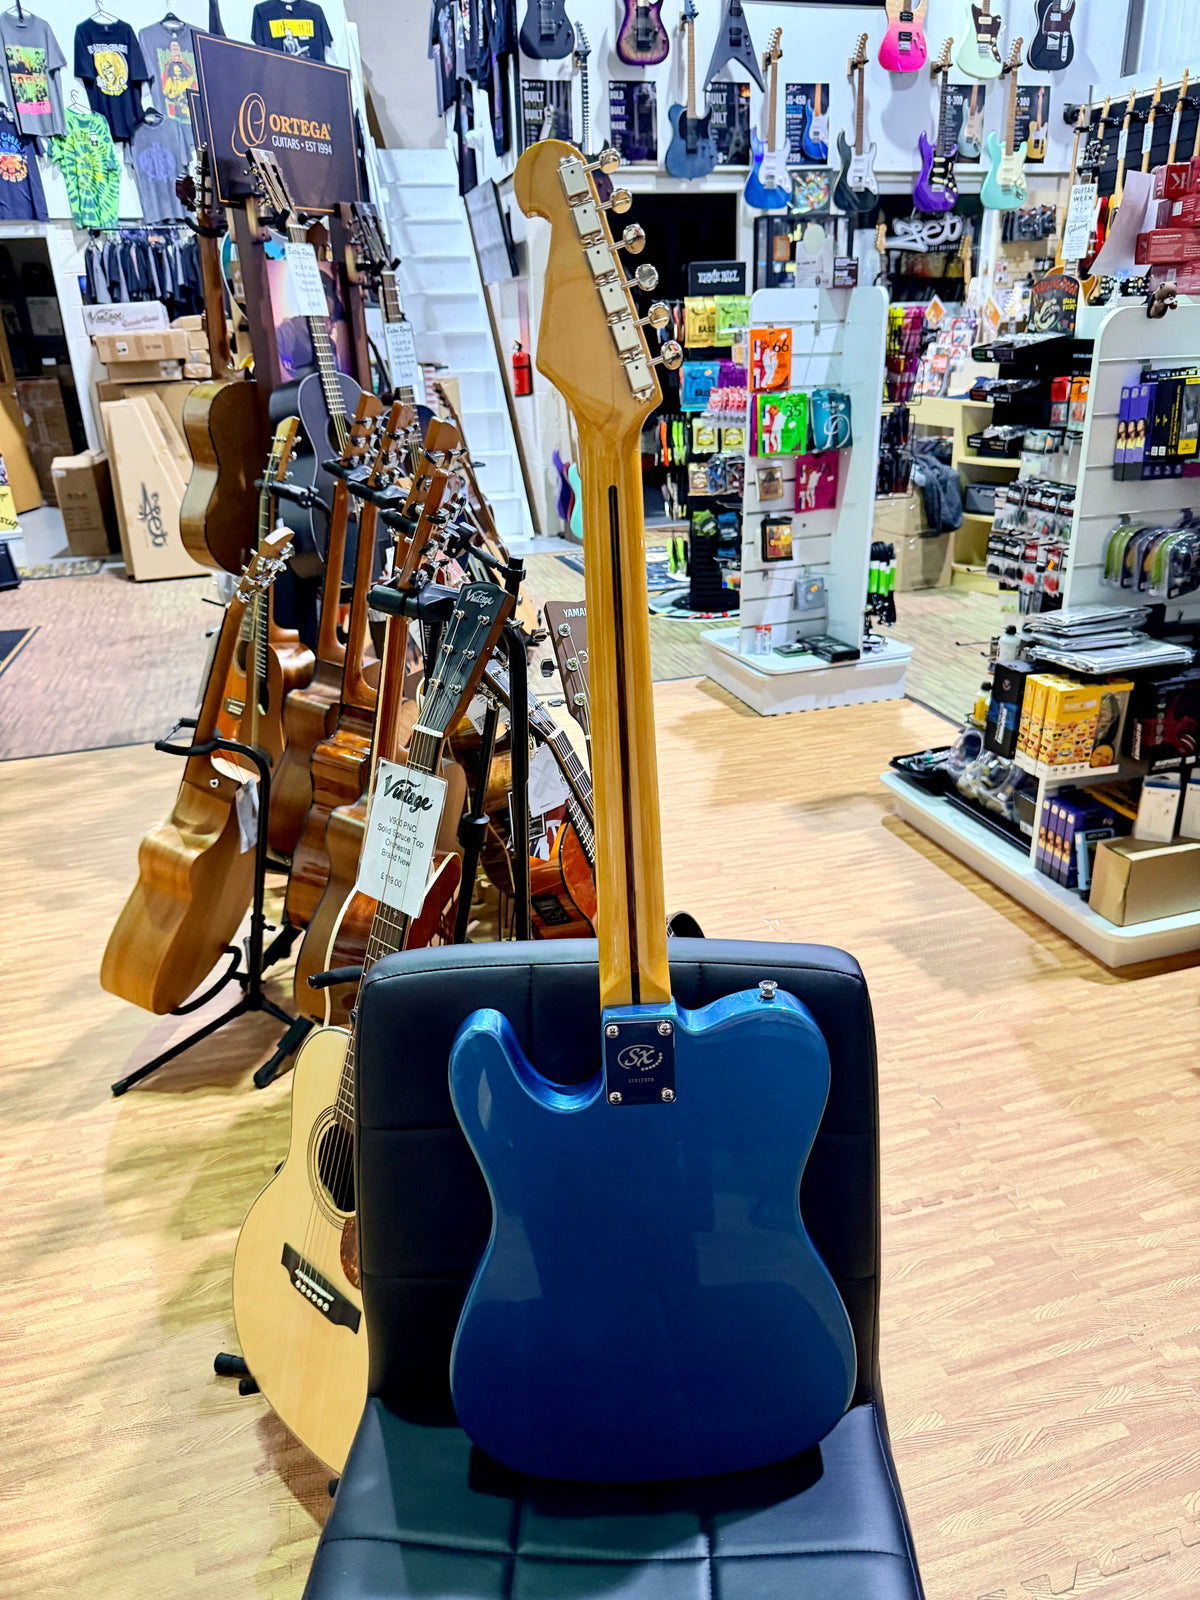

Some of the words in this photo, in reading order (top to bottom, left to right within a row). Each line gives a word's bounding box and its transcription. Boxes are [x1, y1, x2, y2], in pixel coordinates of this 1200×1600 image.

[523, 90, 544, 102] BUILT
[609, 90, 624, 100] BOLD
[524, 109, 543, 120] BUILT
[711, 111, 728, 124] UILT
[269, 113, 331, 140] ORTEGA
[271, 135, 301, 151] GUITARS
[305, 141, 317, 153] EST
[317, 143, 333, 156] 1994
[1073, 186, 1095, 195] GUITAR
[772, 339, 790, 353] 66
[786, 404, 802, 418] 35
[465, 588, 495, 608] Vintage
[563, 607, 587, 618] YAMA
[384, 774, 434, 813] Vintage
[413, 836, 425, 849] Top
[397, 855, 411, 868] New
[620, 1046, 658, 1068] SX
